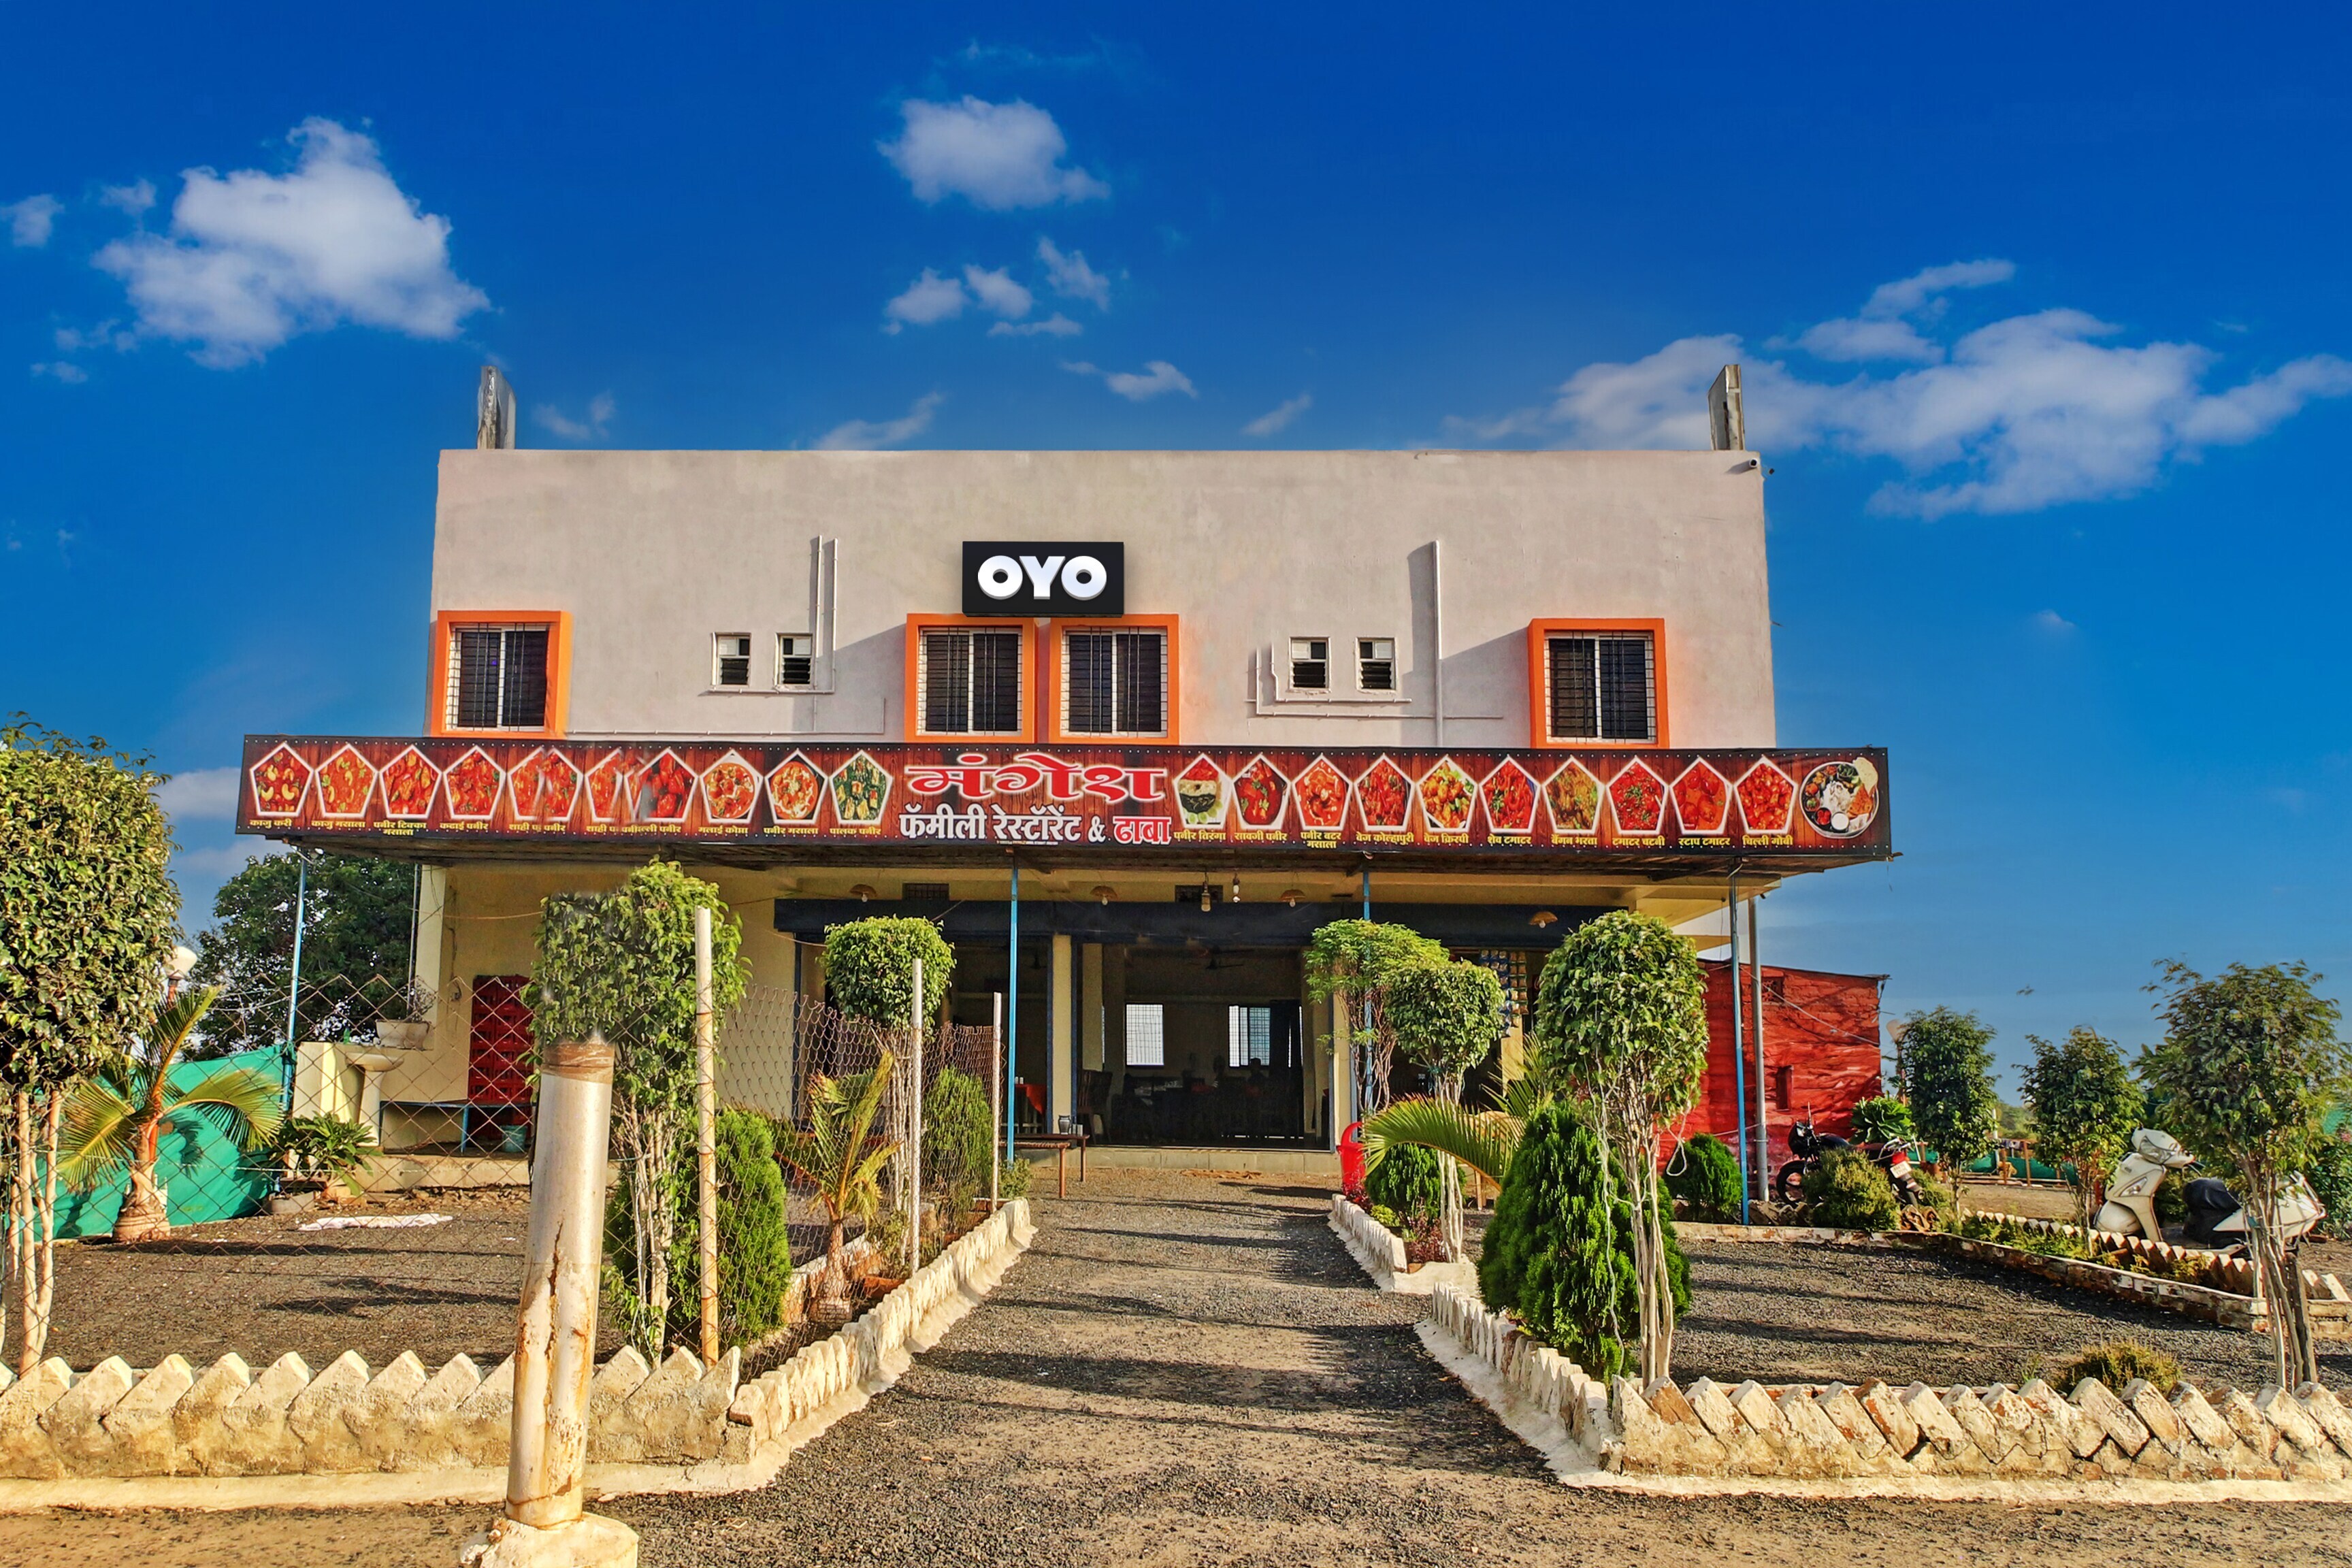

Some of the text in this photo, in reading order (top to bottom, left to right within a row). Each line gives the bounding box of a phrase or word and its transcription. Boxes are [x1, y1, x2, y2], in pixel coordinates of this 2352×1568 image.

[977, 555, 1107, 600] OYO
[906, 753, 1167, 802] मंगेश
[374, 820, 395, 828] पनीर
[466, 821, 489, 830] पनीर
[764, 826, 785, 834] पनीर
[859, 826, 881, 835] पनीर
[1088, 815, 1106, 841] &
[1113, 816, 1171, 844] ढाबा
[1173, 830, 1196, 840] पनीर
[1266, 831, 1287, 841] पनीर
[1301, 830, 1322, 840] पनीर
[1612, 837, 1639, 845] टमाटर
[1702, 838, 1730, 846] टमाटर
